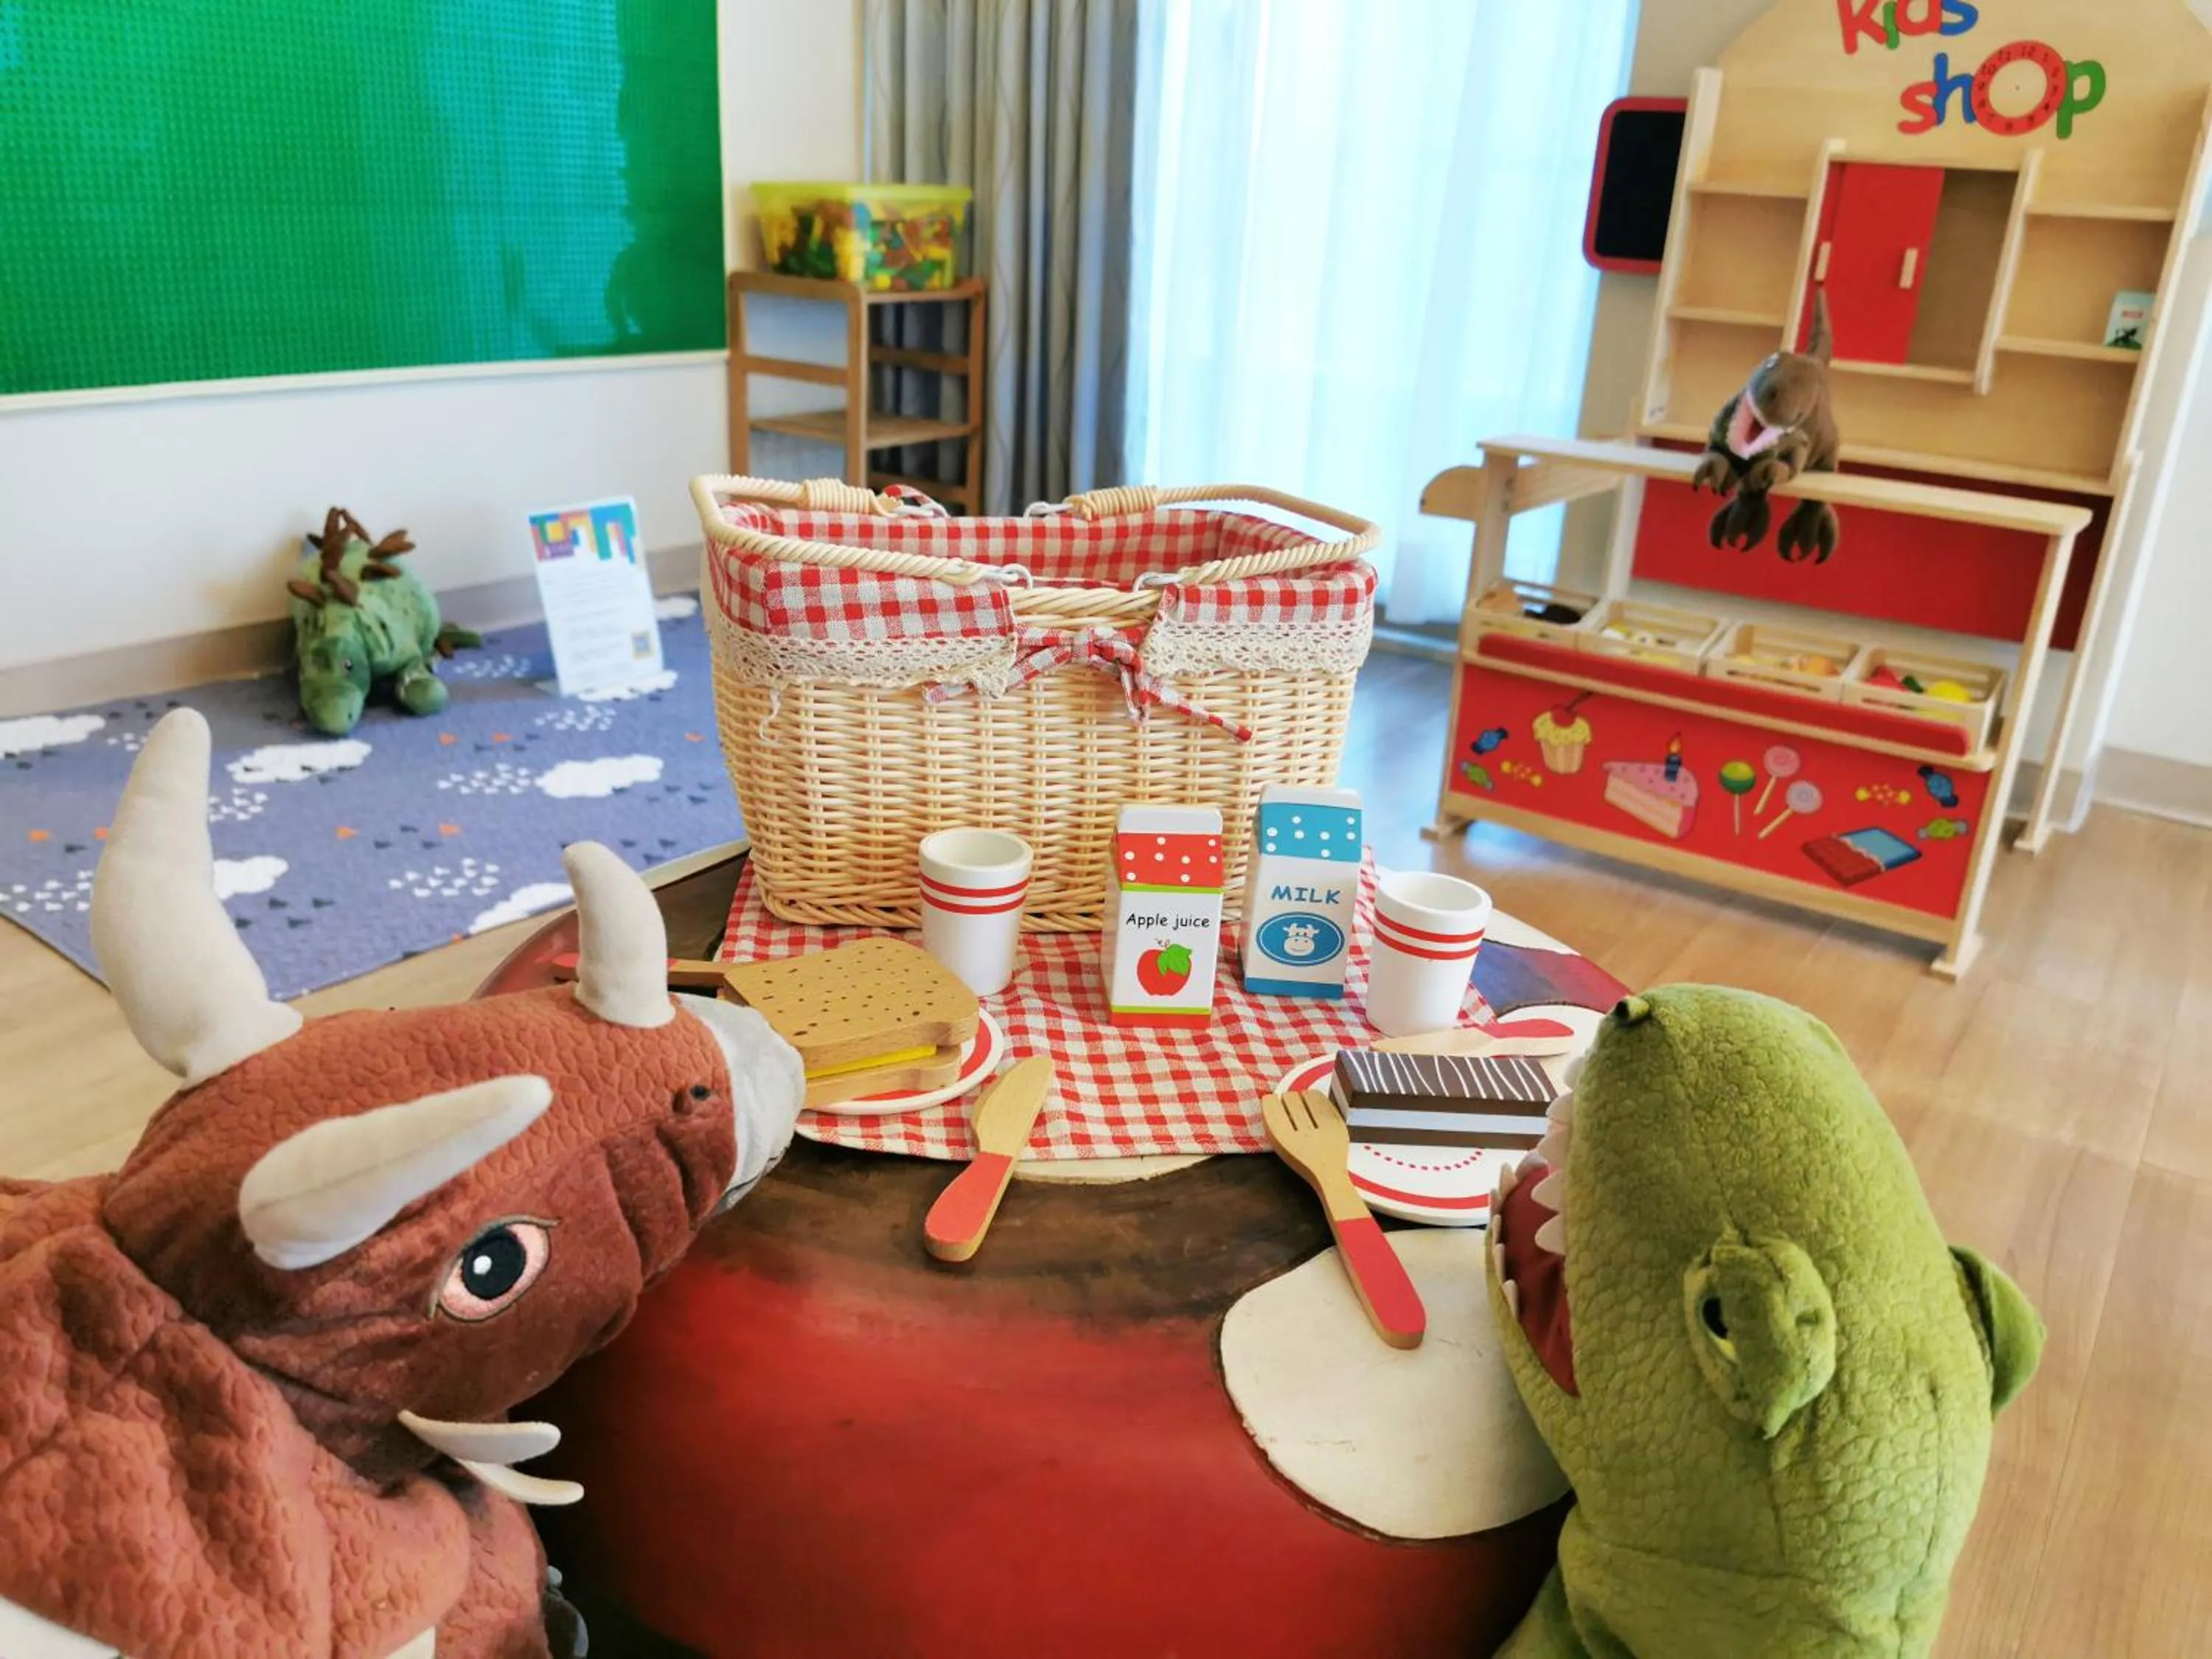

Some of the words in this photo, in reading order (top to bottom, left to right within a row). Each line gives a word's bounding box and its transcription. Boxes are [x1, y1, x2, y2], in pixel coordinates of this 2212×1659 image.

[1270, 885, 1342, 905] MILK
[1126, 913, 1168, 929] Apple
[1172, 913, 1211, 931] juice
